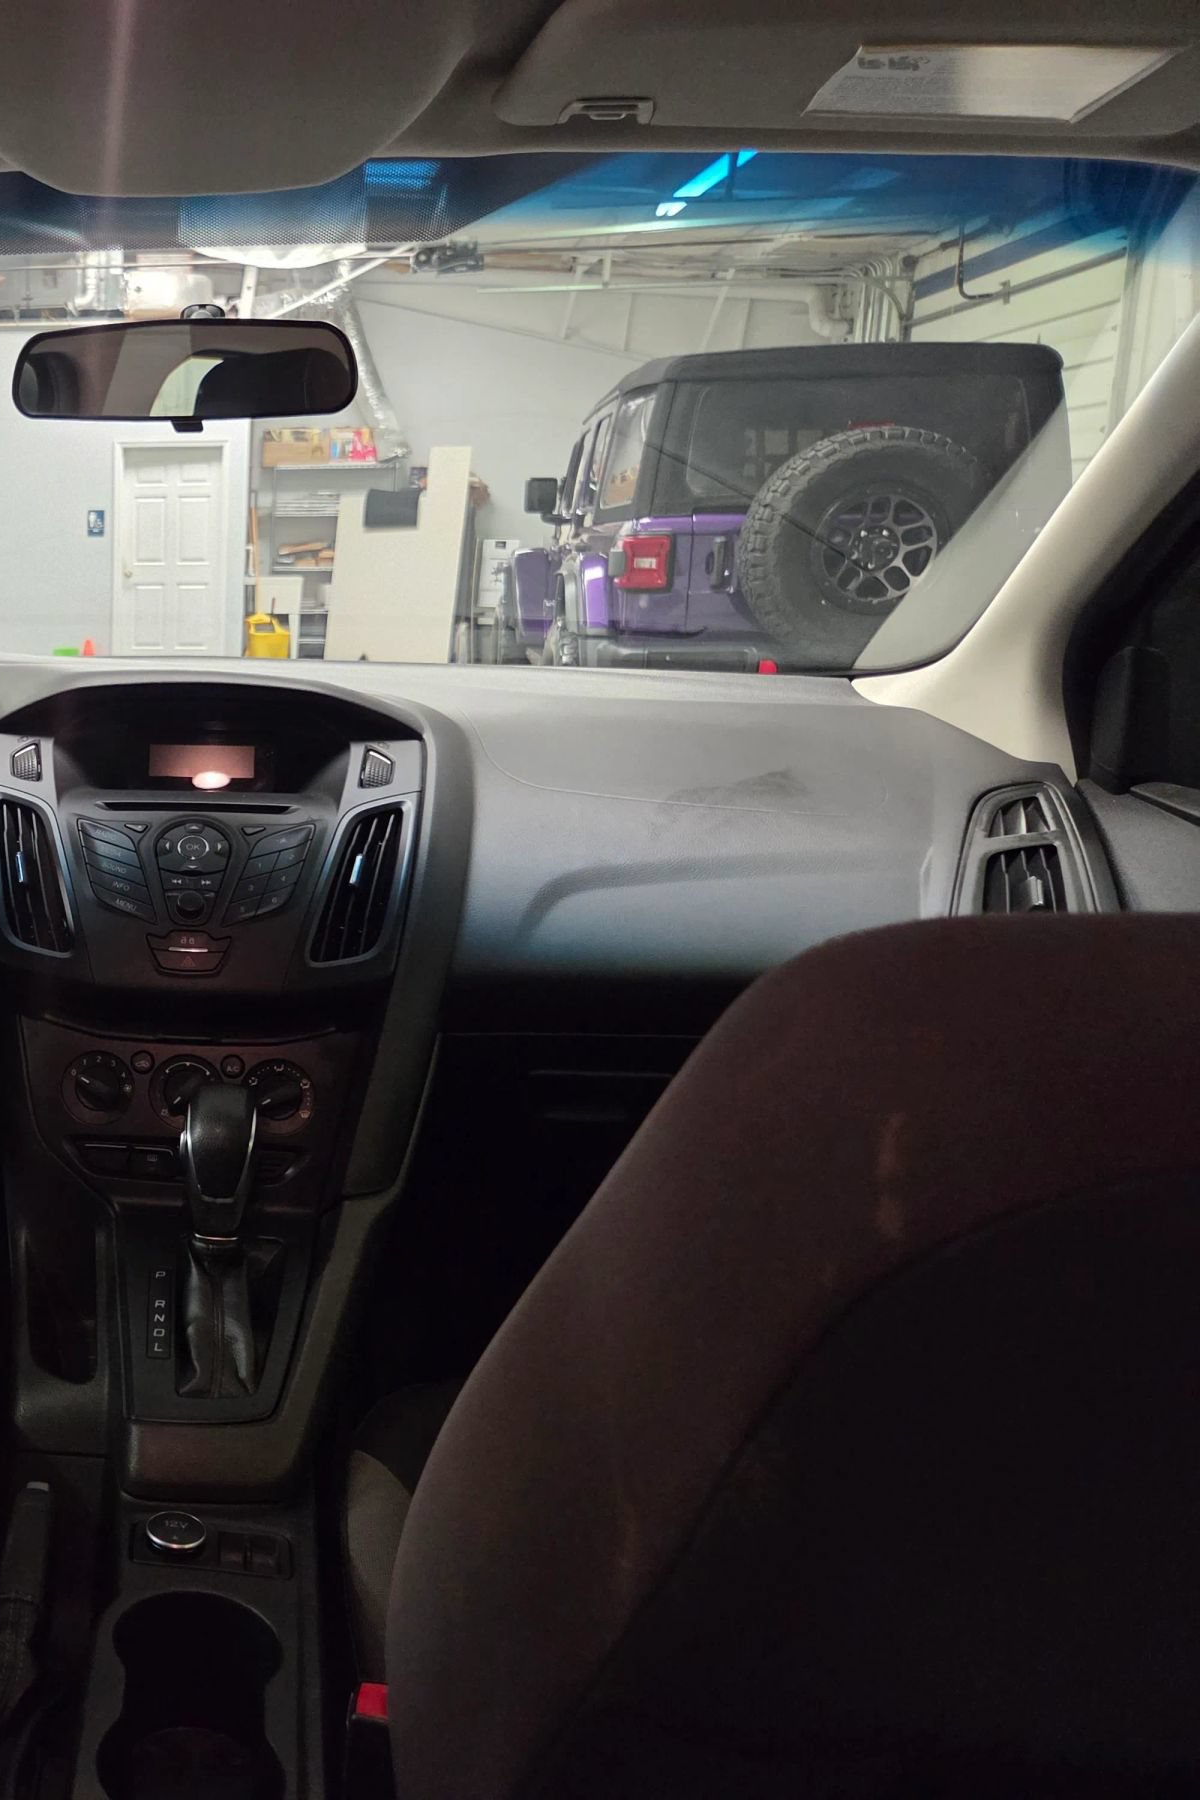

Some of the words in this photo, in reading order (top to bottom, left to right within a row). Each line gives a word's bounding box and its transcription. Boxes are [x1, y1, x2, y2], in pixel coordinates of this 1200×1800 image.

[185, 843, 201, 851] OK
[115, 898, 137, 911] MENU
[155, 1271, 166, 1279] P
[154, 1300, 166, 1308] R
[154, 1314, 165, 1322] N
[153, 1328, 165, 1337] D
[154, 1343, 163, 1352] L
[164, 1519, 189, 1529] 12V
